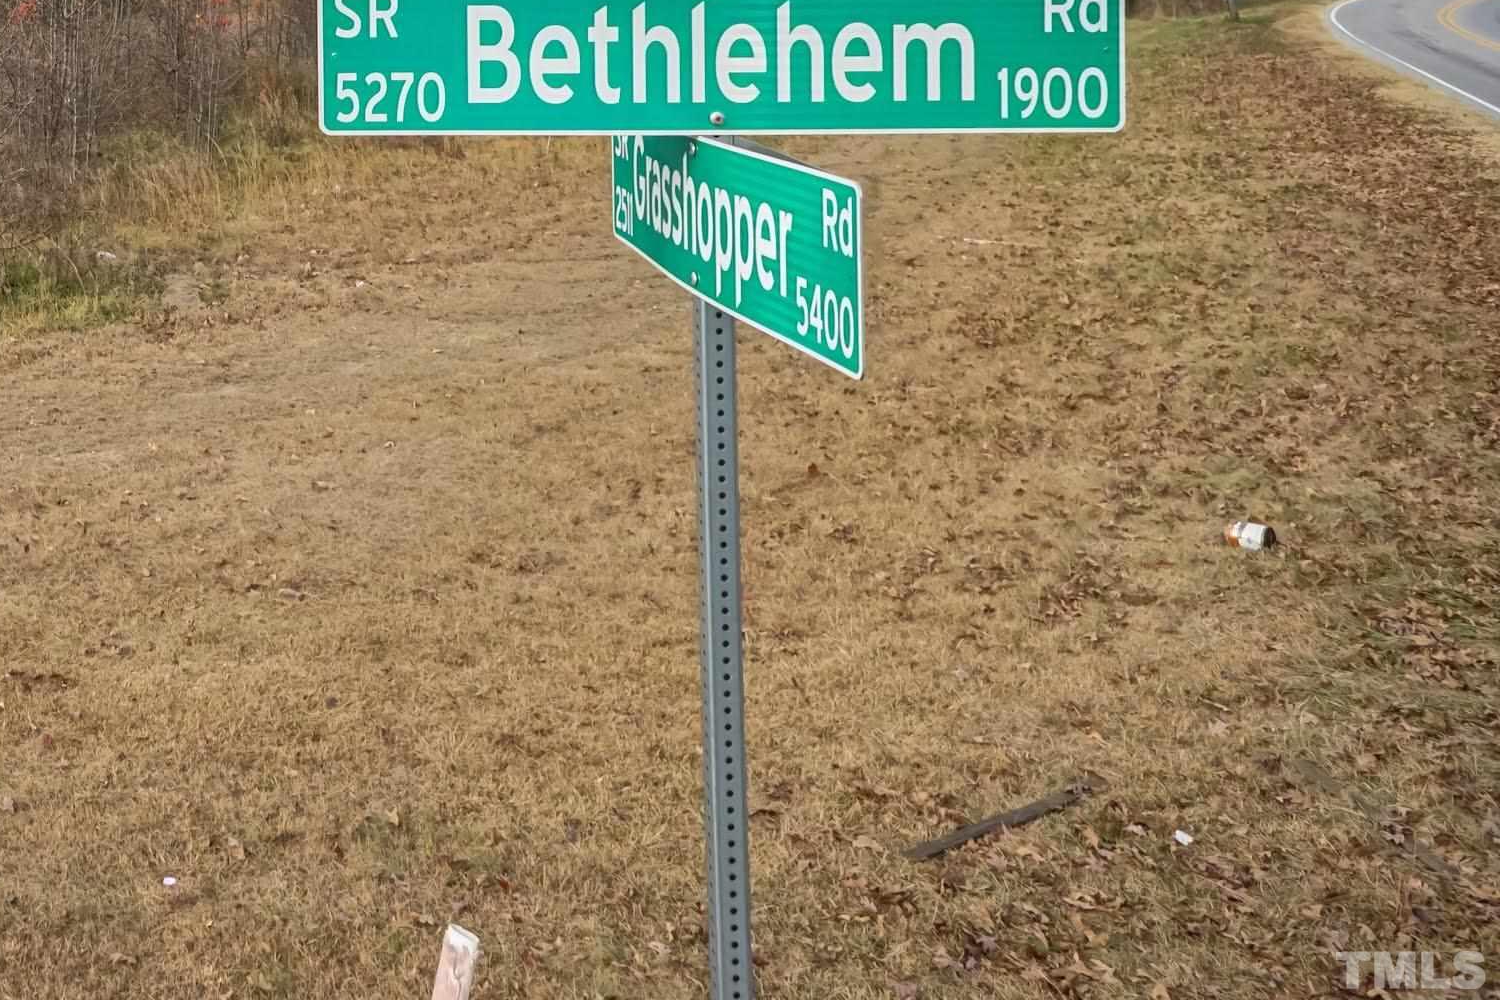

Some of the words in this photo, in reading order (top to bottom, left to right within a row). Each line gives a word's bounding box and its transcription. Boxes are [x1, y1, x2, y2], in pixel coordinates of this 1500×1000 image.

[466, 0, 976, 105] Bethlehem
[336, 72, 446, 123] 5270
[997, 67, 1108, 119] 1900
[616, 185, 634, 237] 2511
[633, 134, 793, 308] Grasshopper
[822, 188, 853, 257] Rd
[796, 276, 855, 358] 5400
